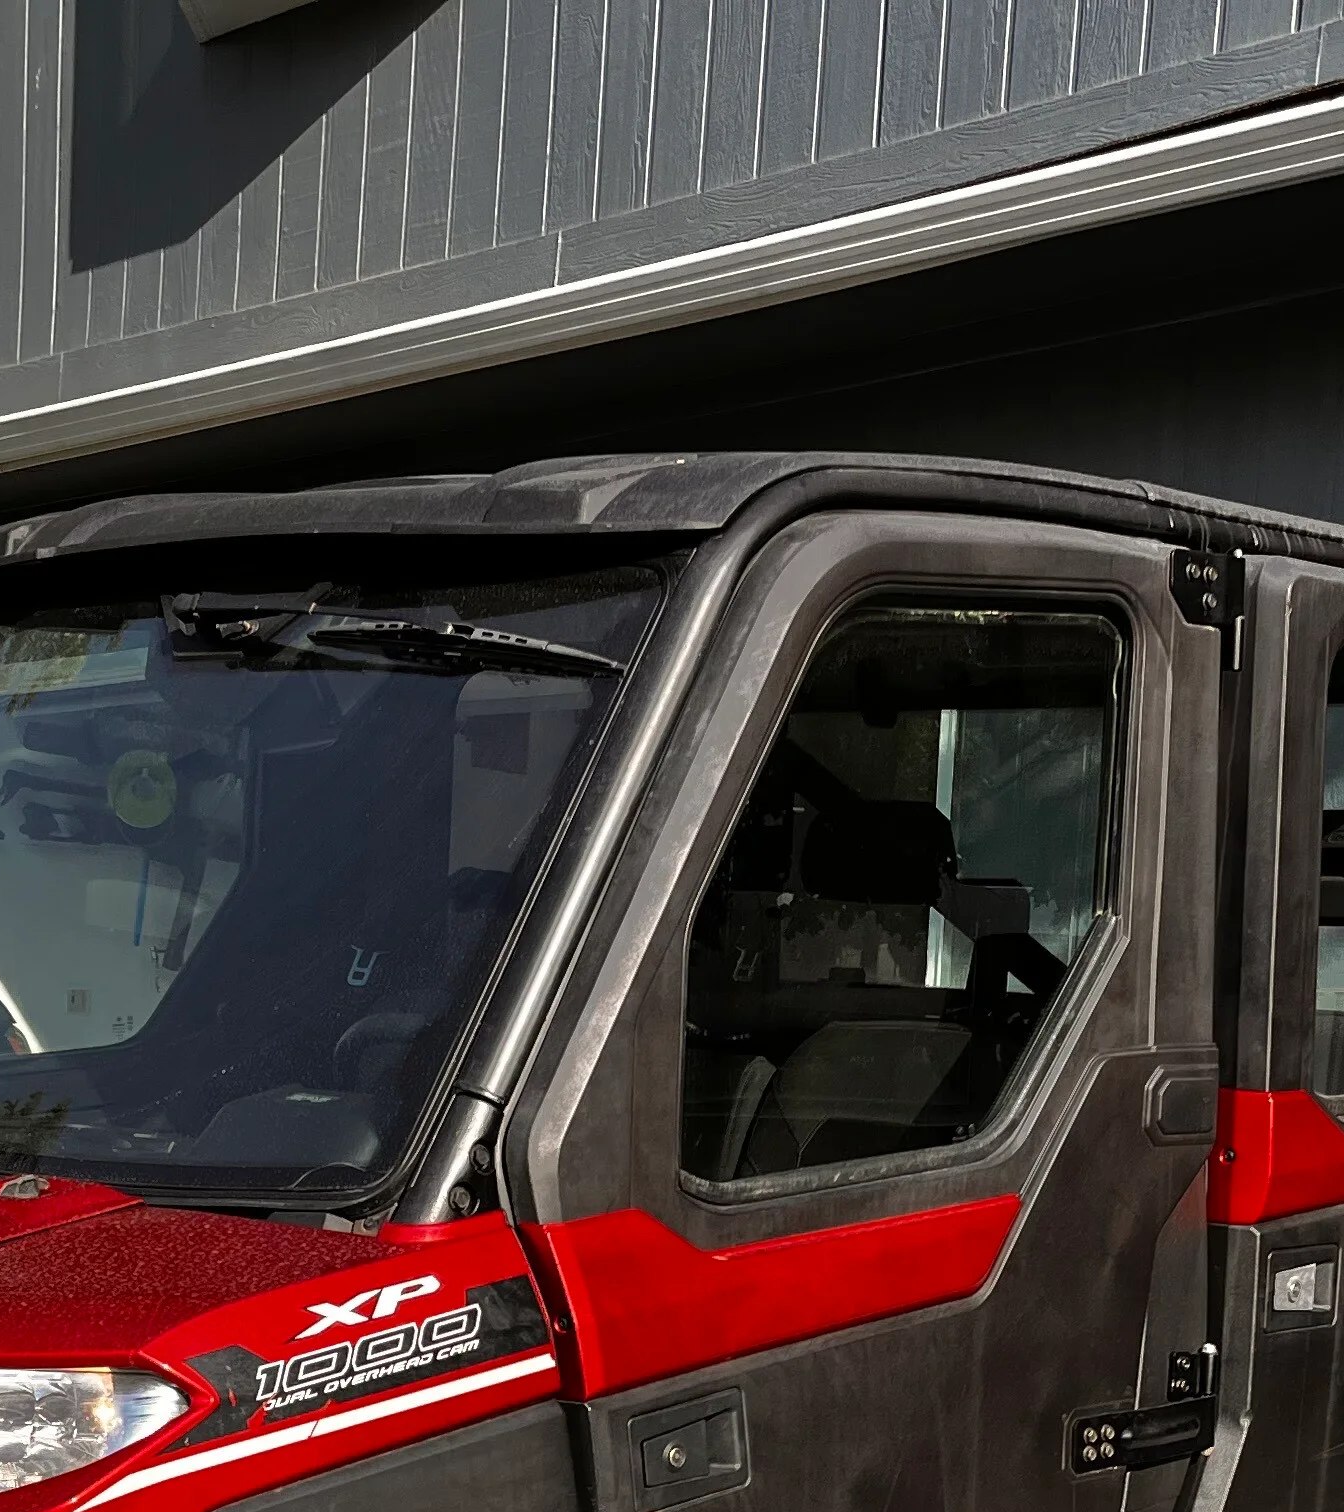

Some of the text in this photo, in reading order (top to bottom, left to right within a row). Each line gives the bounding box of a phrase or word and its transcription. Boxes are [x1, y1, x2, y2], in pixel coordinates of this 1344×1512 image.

[293, 1274, 442, 1341] XP
[255, 1303, 482, 1402] 1000
[263, 1338, 481, 1412] DUAL OVERHEAD CAM
